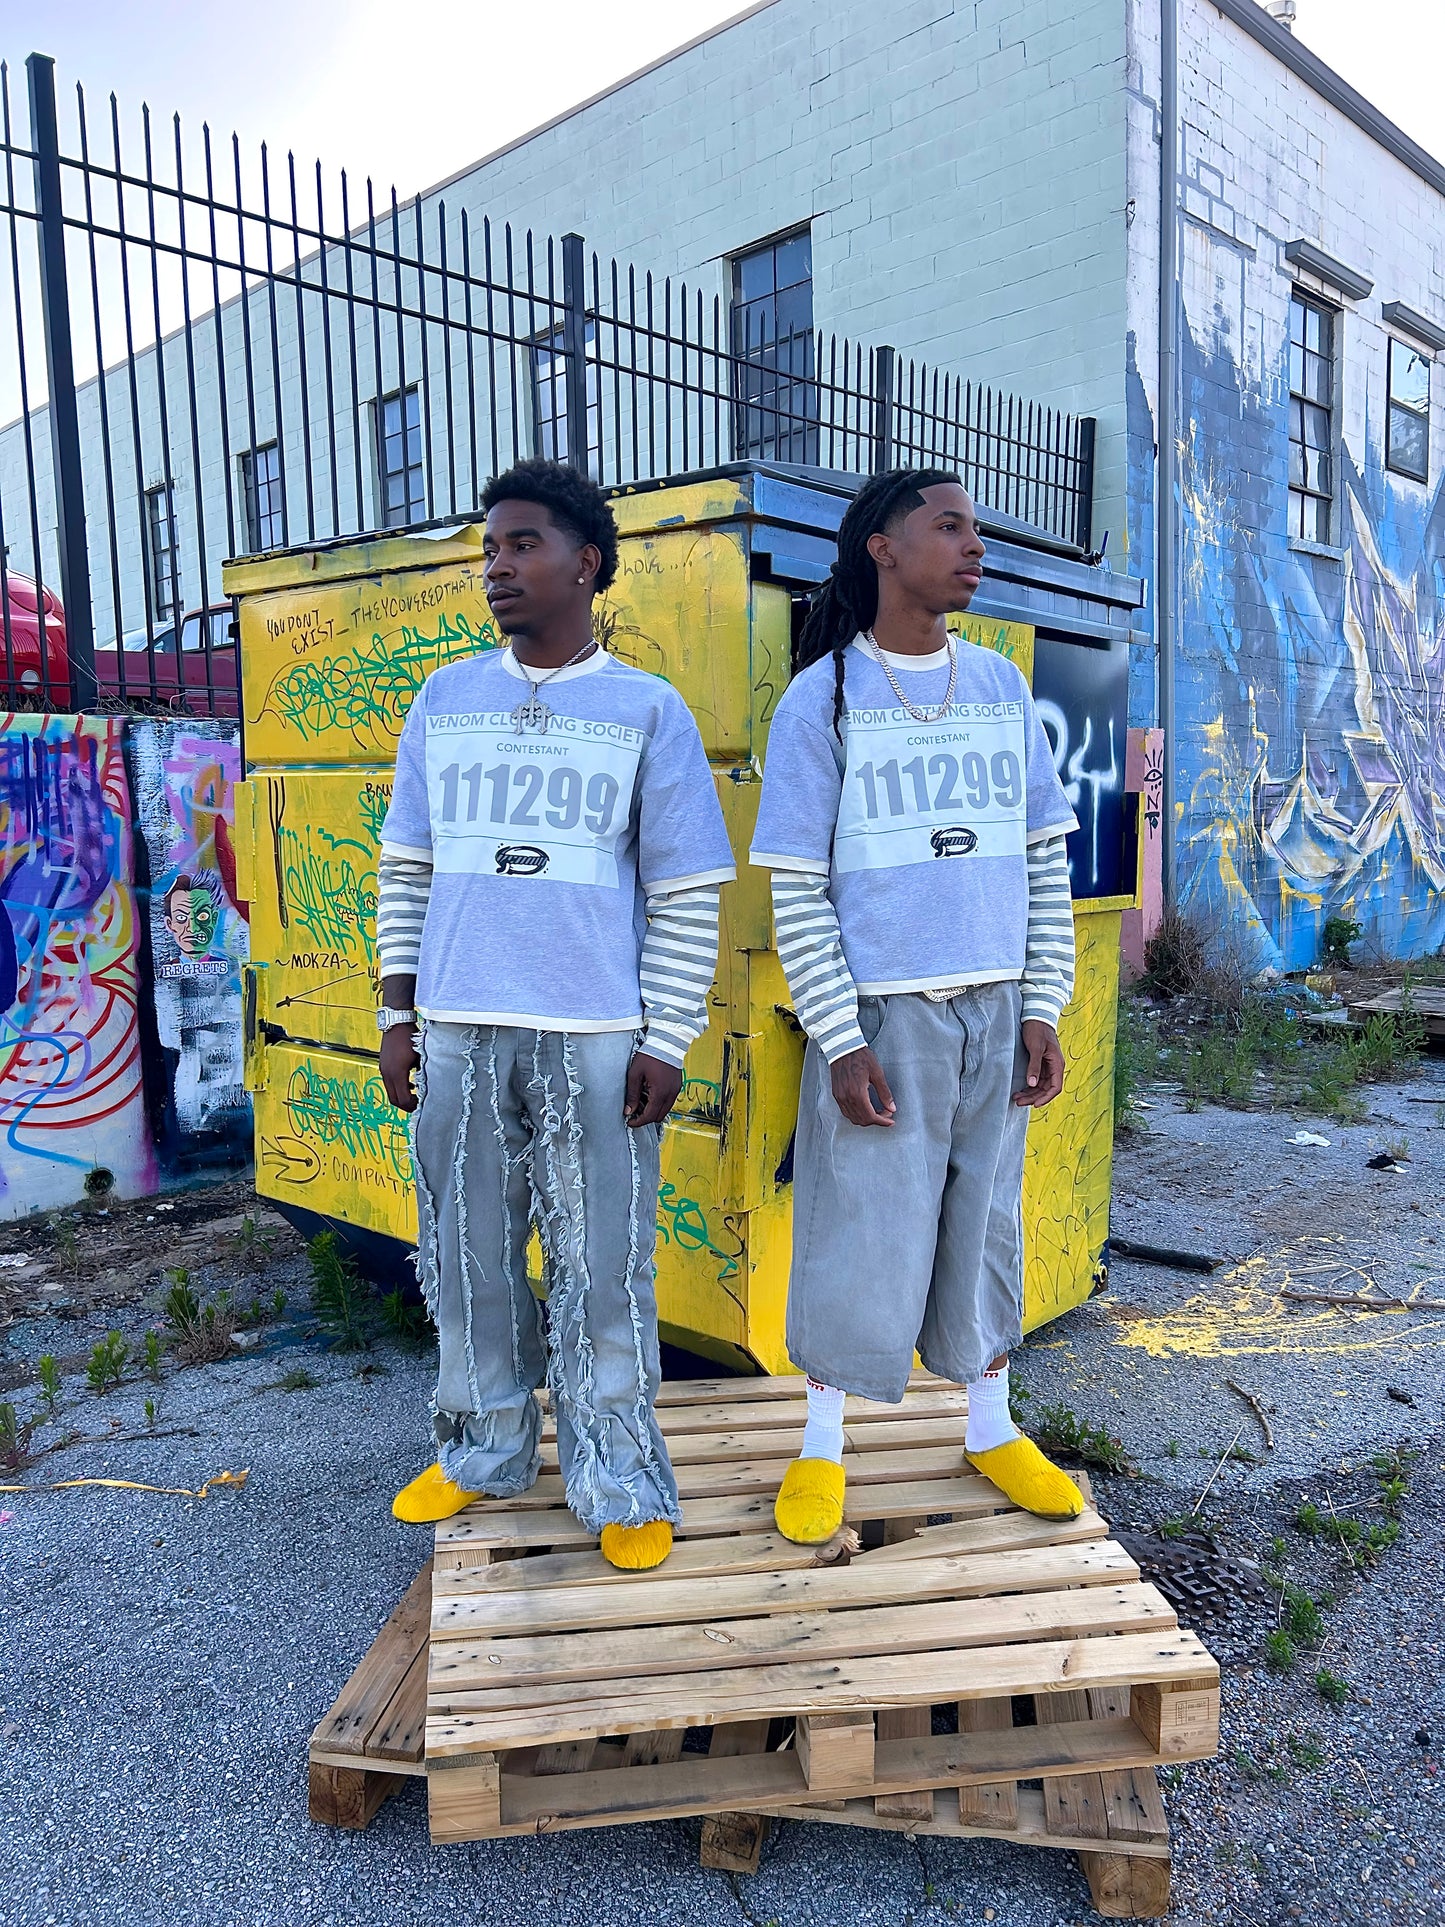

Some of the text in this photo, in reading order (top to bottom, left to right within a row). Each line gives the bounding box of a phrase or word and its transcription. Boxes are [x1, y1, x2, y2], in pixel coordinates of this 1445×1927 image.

[844, 710, 887, 725] ENOM
[974, 702, 1023, 717] SOCIET
[429, 713, 485, 730] VENOM
[582, 722, 645, 744] SOCIET
[906, 732, 971, 746] CONTESTANT
[496, 742, 570, 756] CONTESTANT
[855, 750, 1022, 819] 111299
[439, 761, 619, 835] 111299
[162, 961, 228, 977] REGRETS
